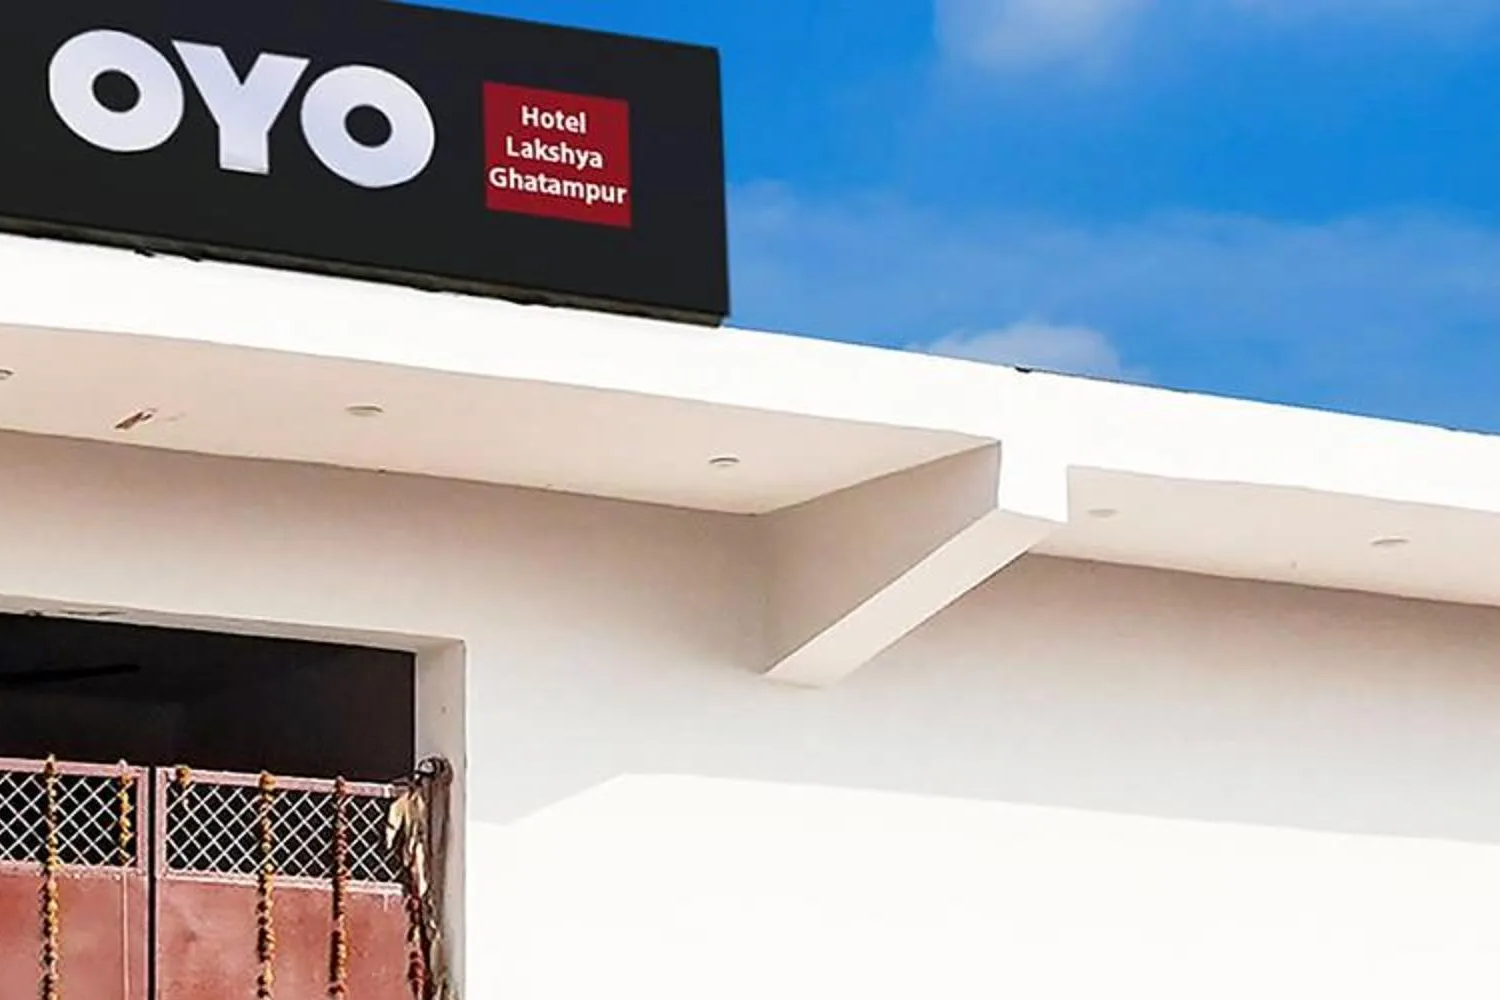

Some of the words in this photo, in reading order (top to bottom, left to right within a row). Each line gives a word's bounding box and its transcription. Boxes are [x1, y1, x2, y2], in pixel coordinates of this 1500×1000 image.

[48, 29, 435, 188] OYO
[521, 105, 587, 133] Hotel
[506, 136, 604, 170] Lakshya
[489, 167, 628, 205] Ghatampur
